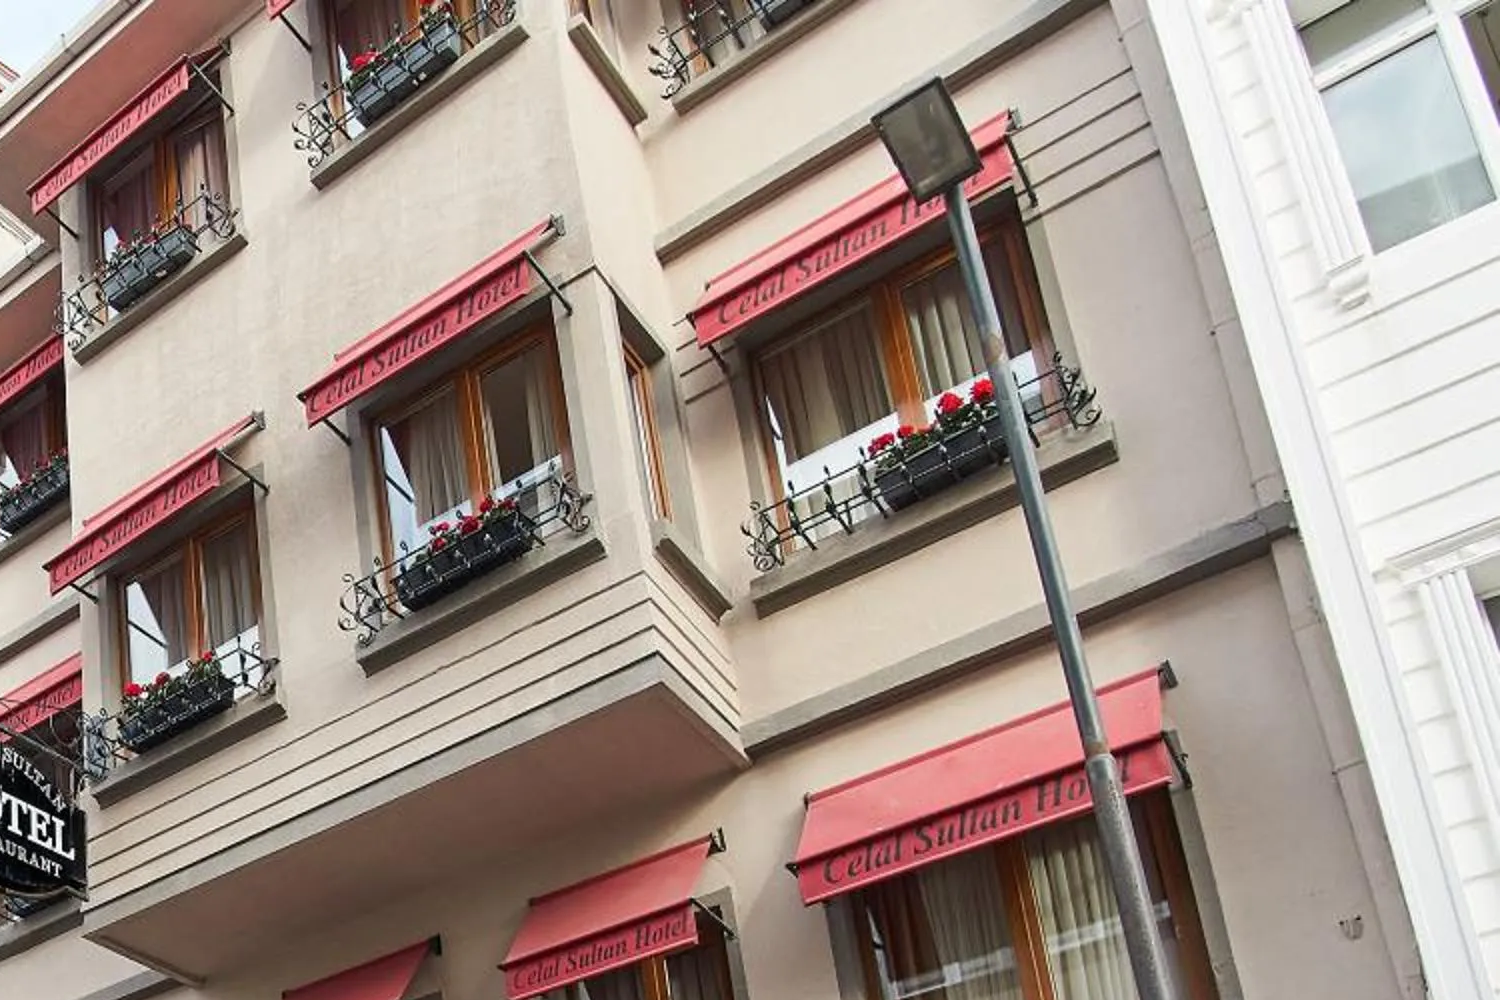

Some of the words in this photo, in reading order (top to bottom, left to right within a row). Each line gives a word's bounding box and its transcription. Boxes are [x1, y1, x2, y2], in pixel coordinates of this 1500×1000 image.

[717, 270, 789, 326] Celal
[796, 221, 887, 283] Sultan
[309, 358, 365, 412] Celal
[371, 320, 447, 377] Sultan
[455, 259, 522, 325] Hotel
[53, 544, 95, 582] Celal
[100, 507, 156, 552] Sultan
[163, 463, 213, 510] Hotel
[2, 747, 66, 813] SULTAN
[823, 837, 900, 885] Celal
[913, 800, 1023, 855] Sultan
[1037, 754, 1130, 811] Hol
[513, 958, 560, 990] Celal
[564, 938, 627, 974] Sultan
[634, 917, 689, 954] Hotel
